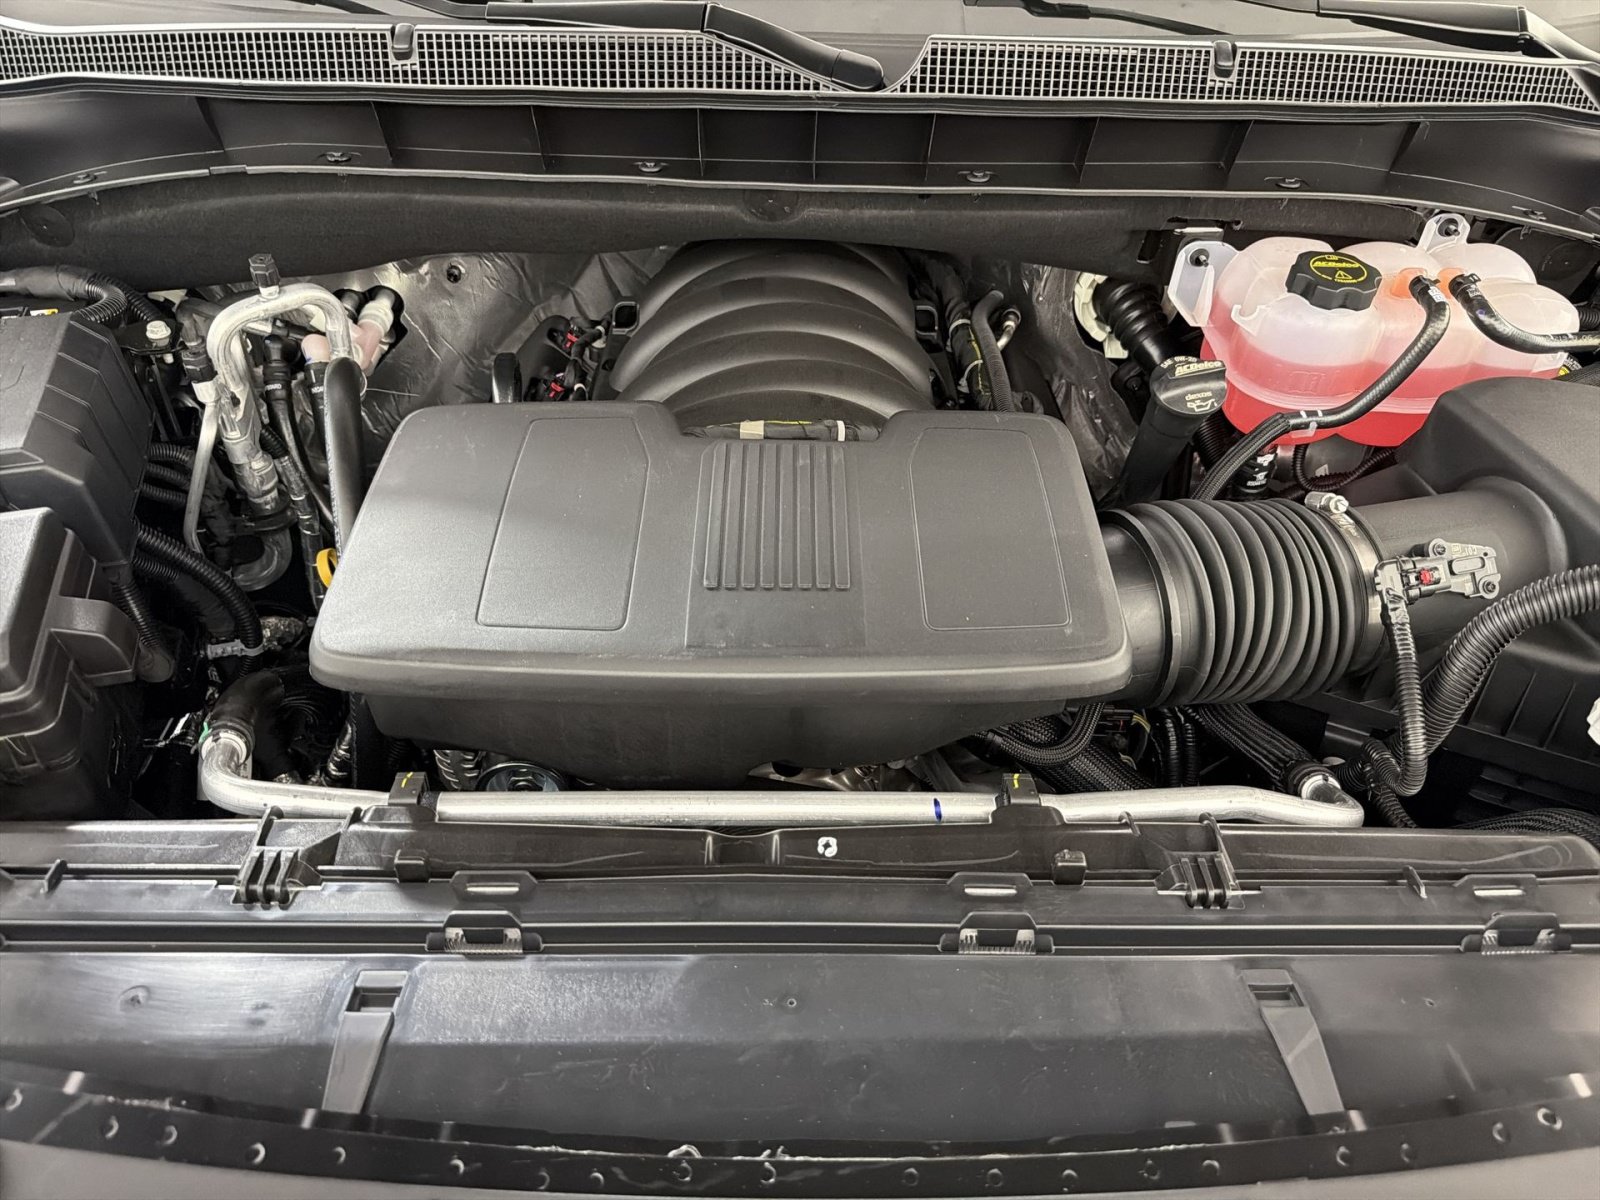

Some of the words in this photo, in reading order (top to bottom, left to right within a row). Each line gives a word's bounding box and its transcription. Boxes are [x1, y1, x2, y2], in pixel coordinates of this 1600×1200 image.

[1160, 359, 1173, 369] SAE
[1174, 360, 1223, 377] ACDelco
[1185, 391, 1212, 400] dexos
